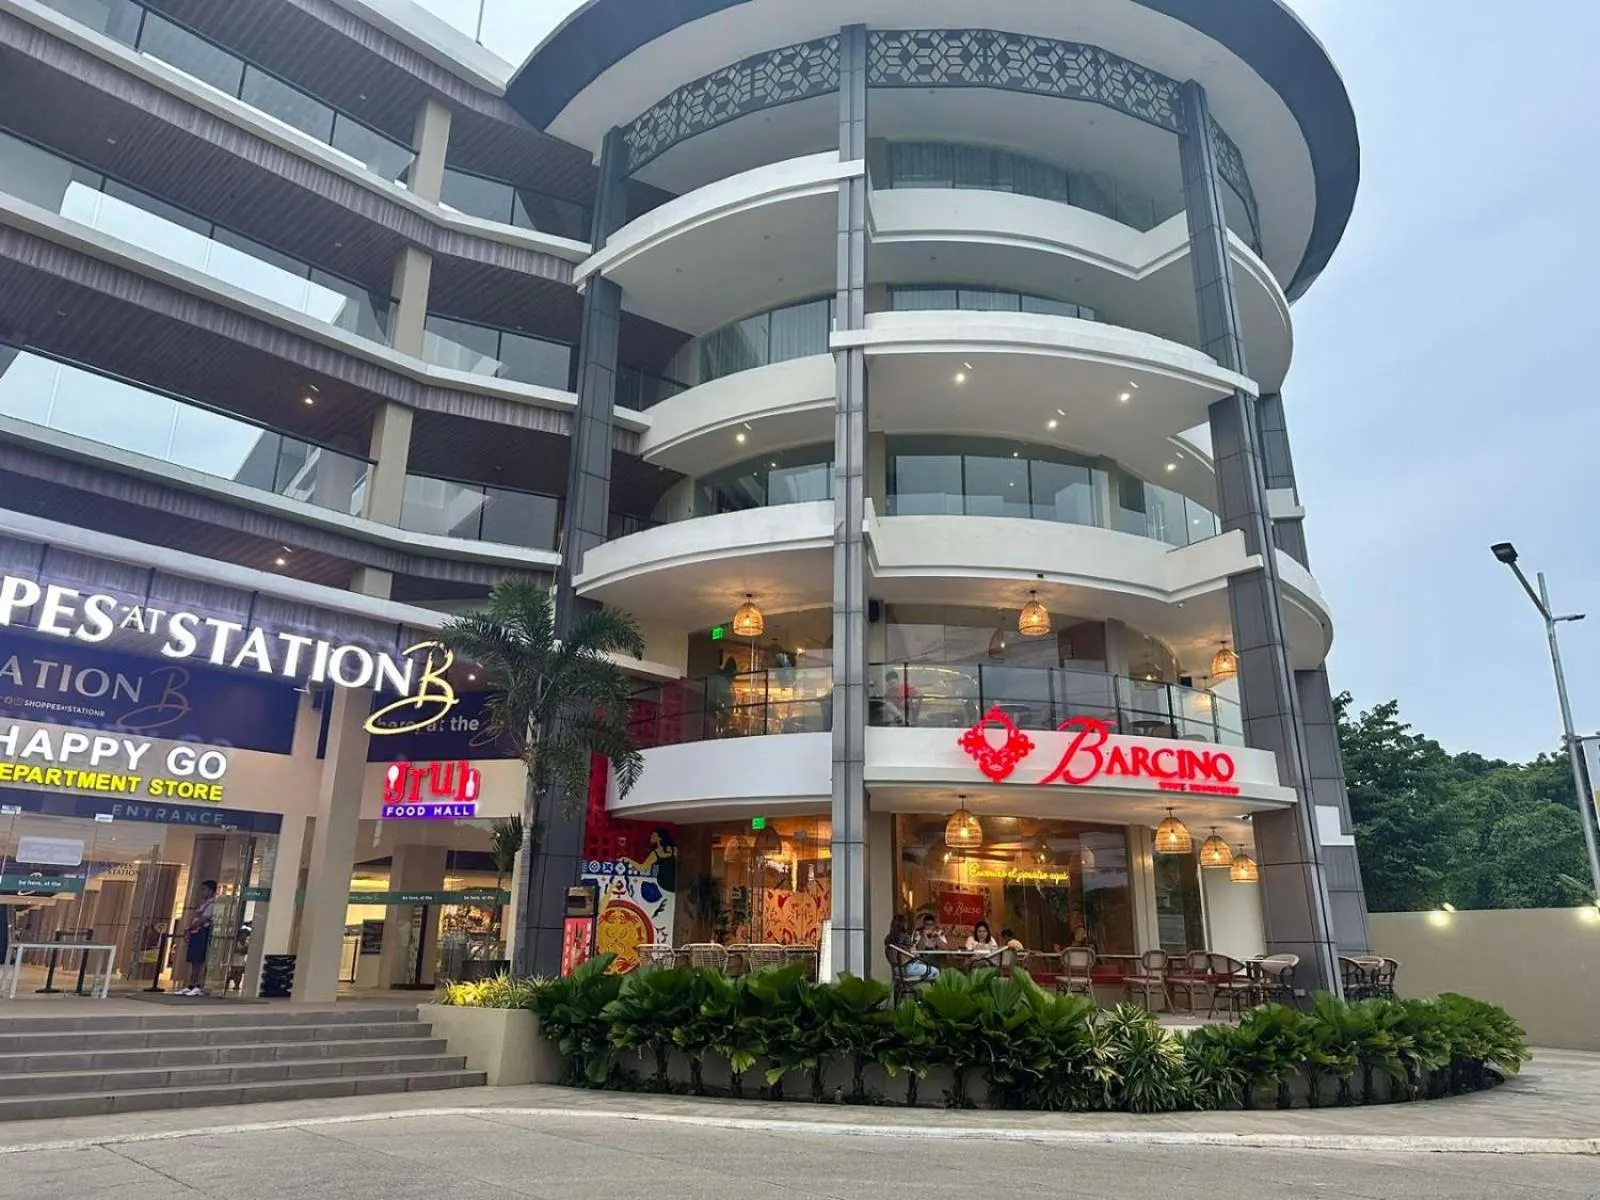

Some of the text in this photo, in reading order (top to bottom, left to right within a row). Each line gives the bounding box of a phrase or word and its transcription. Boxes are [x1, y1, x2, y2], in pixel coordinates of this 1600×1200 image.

[120, 605, 167, 634] AT
[161, 612, 415, 697] STATION
[363, 641, 459, 734] B
[451, 715, 479, 731] the
[0, 725, 227, 780] HAPPY GO
[149, 778, 223, 801] STORE
[112, 803, 225, 825] ENTRANCE
[386, 806, 470, 817] FOOD HALL
